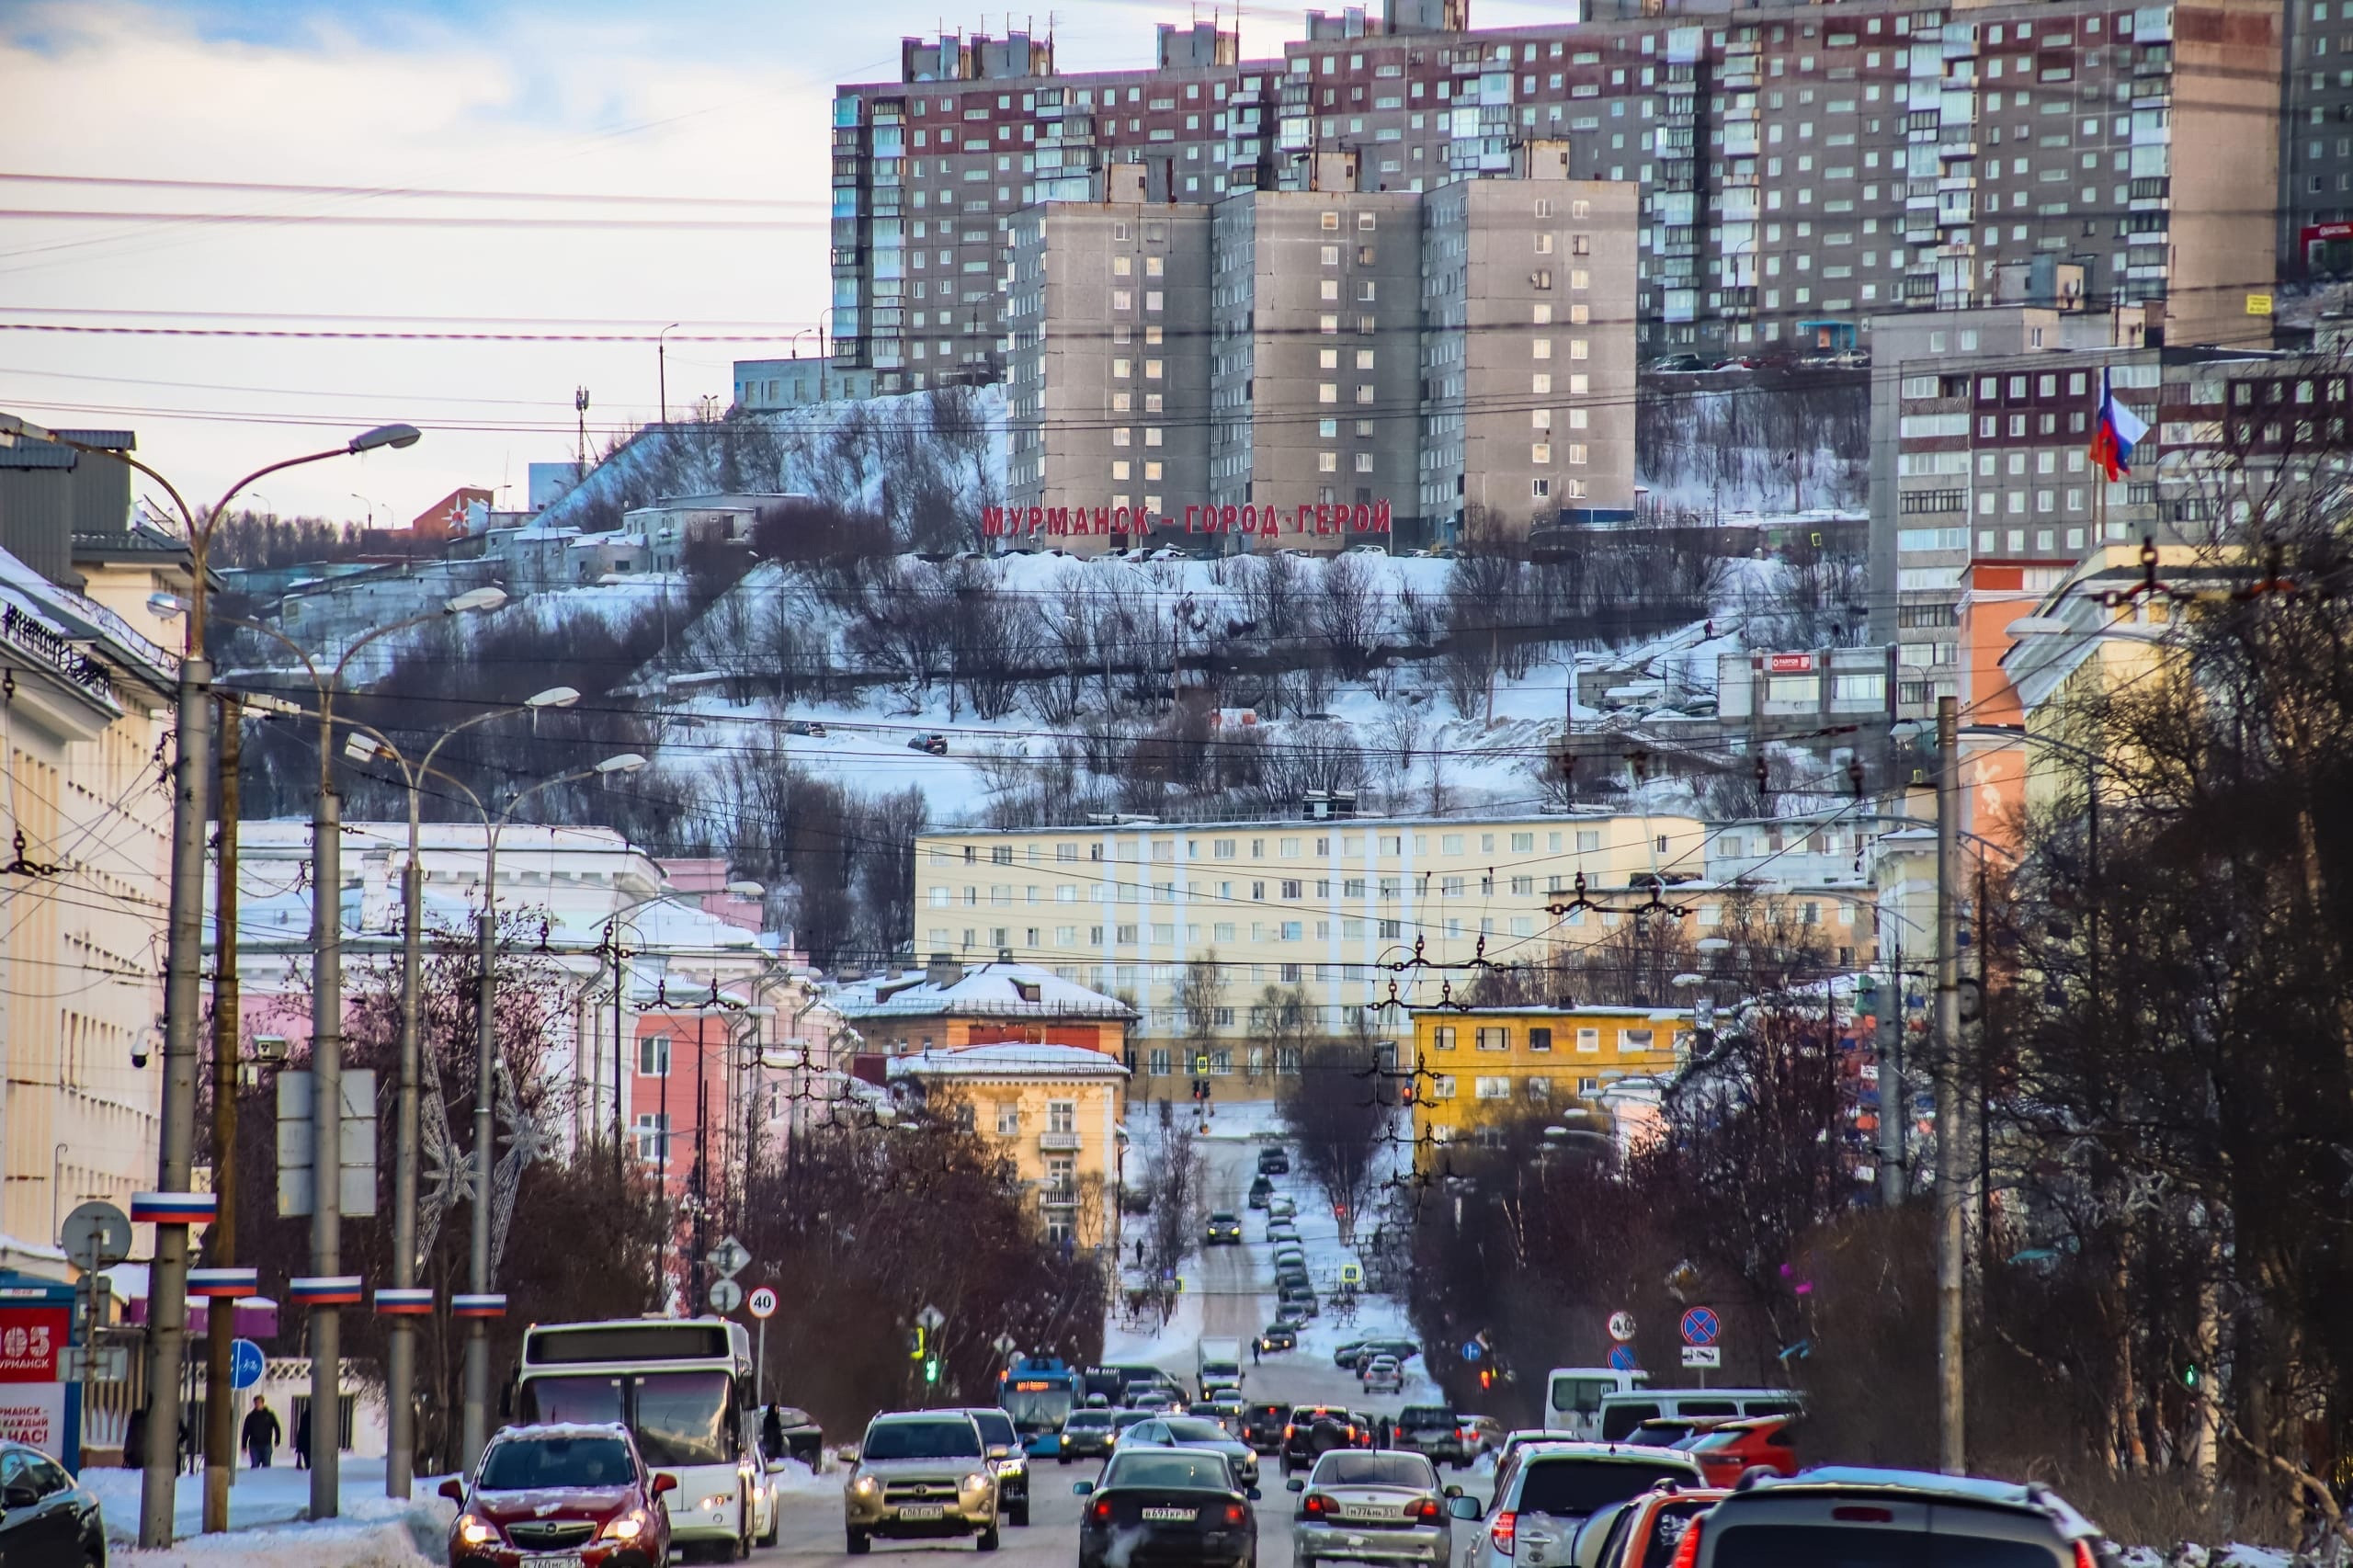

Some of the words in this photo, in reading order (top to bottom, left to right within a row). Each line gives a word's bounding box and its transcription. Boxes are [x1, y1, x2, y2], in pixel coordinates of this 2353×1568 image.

[983, 506, 1150, 537] МУРМАНСК
[754, 1295, 771, 1309] 40
[1612, 1319, 1631, 1333] 40
[0, 1326, 50, 1358] 05
